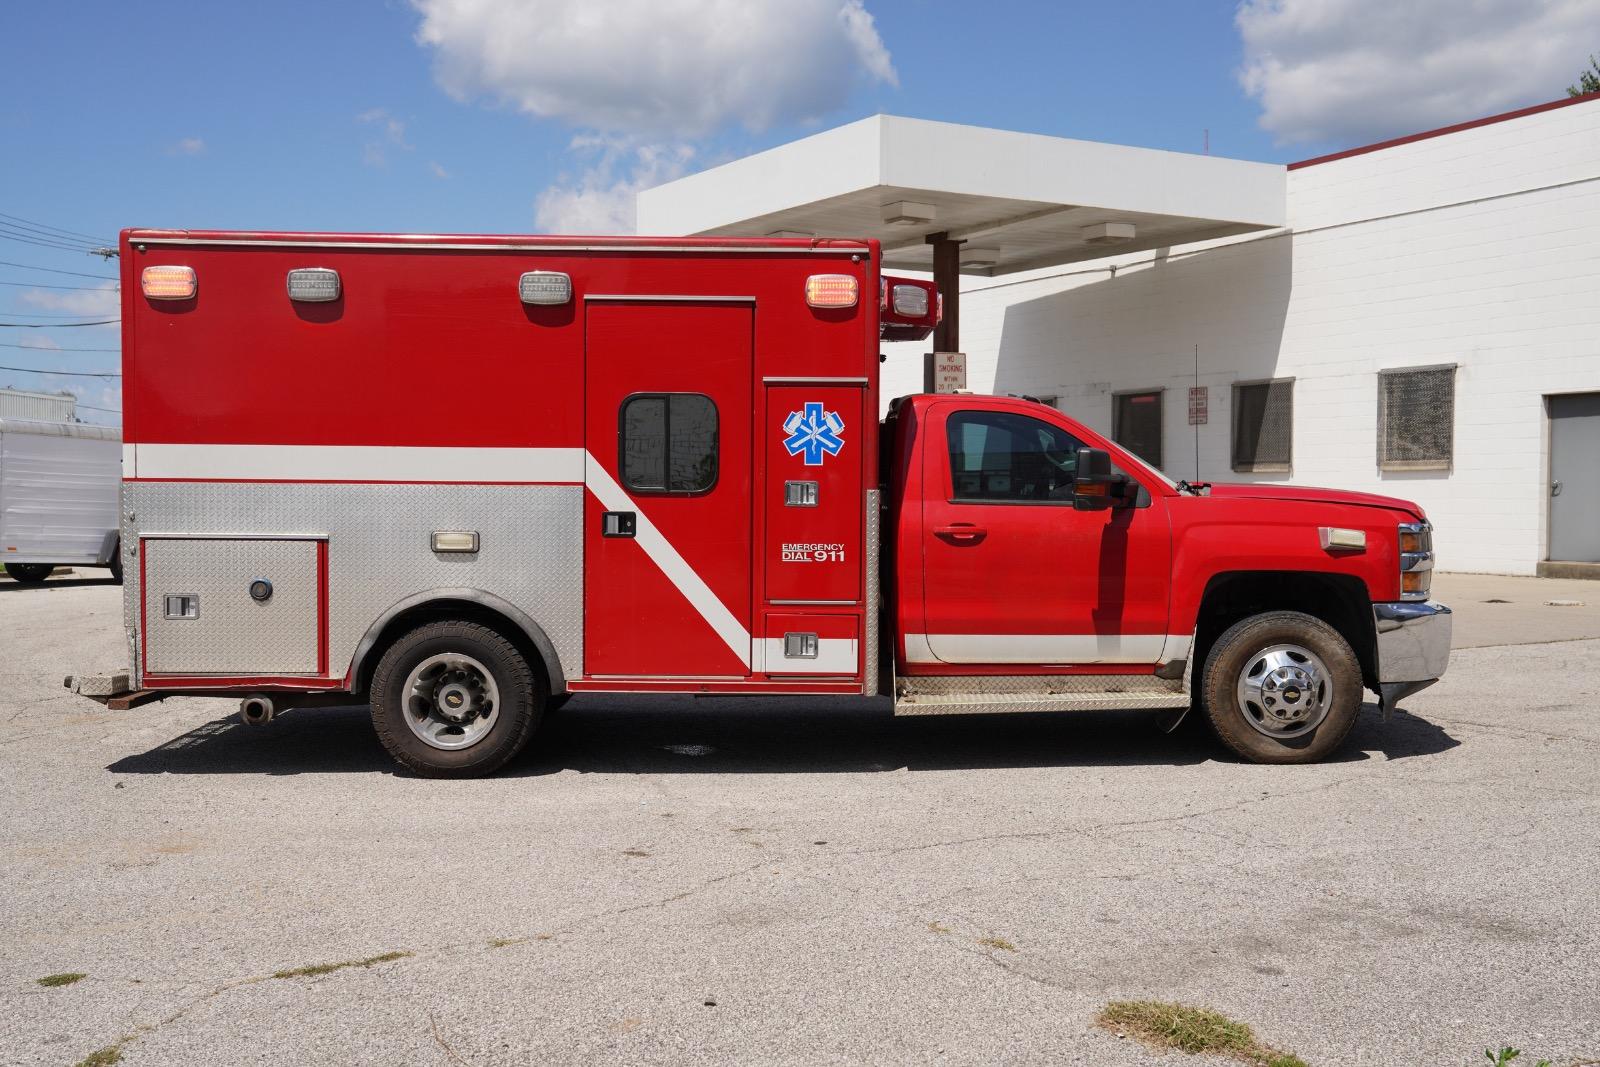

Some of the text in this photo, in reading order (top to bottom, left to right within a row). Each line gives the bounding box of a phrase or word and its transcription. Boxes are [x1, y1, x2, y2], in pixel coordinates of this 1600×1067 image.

[938, 364, 962, 372] SMOKING
[782, 551, 845, 562] DIAL 911
